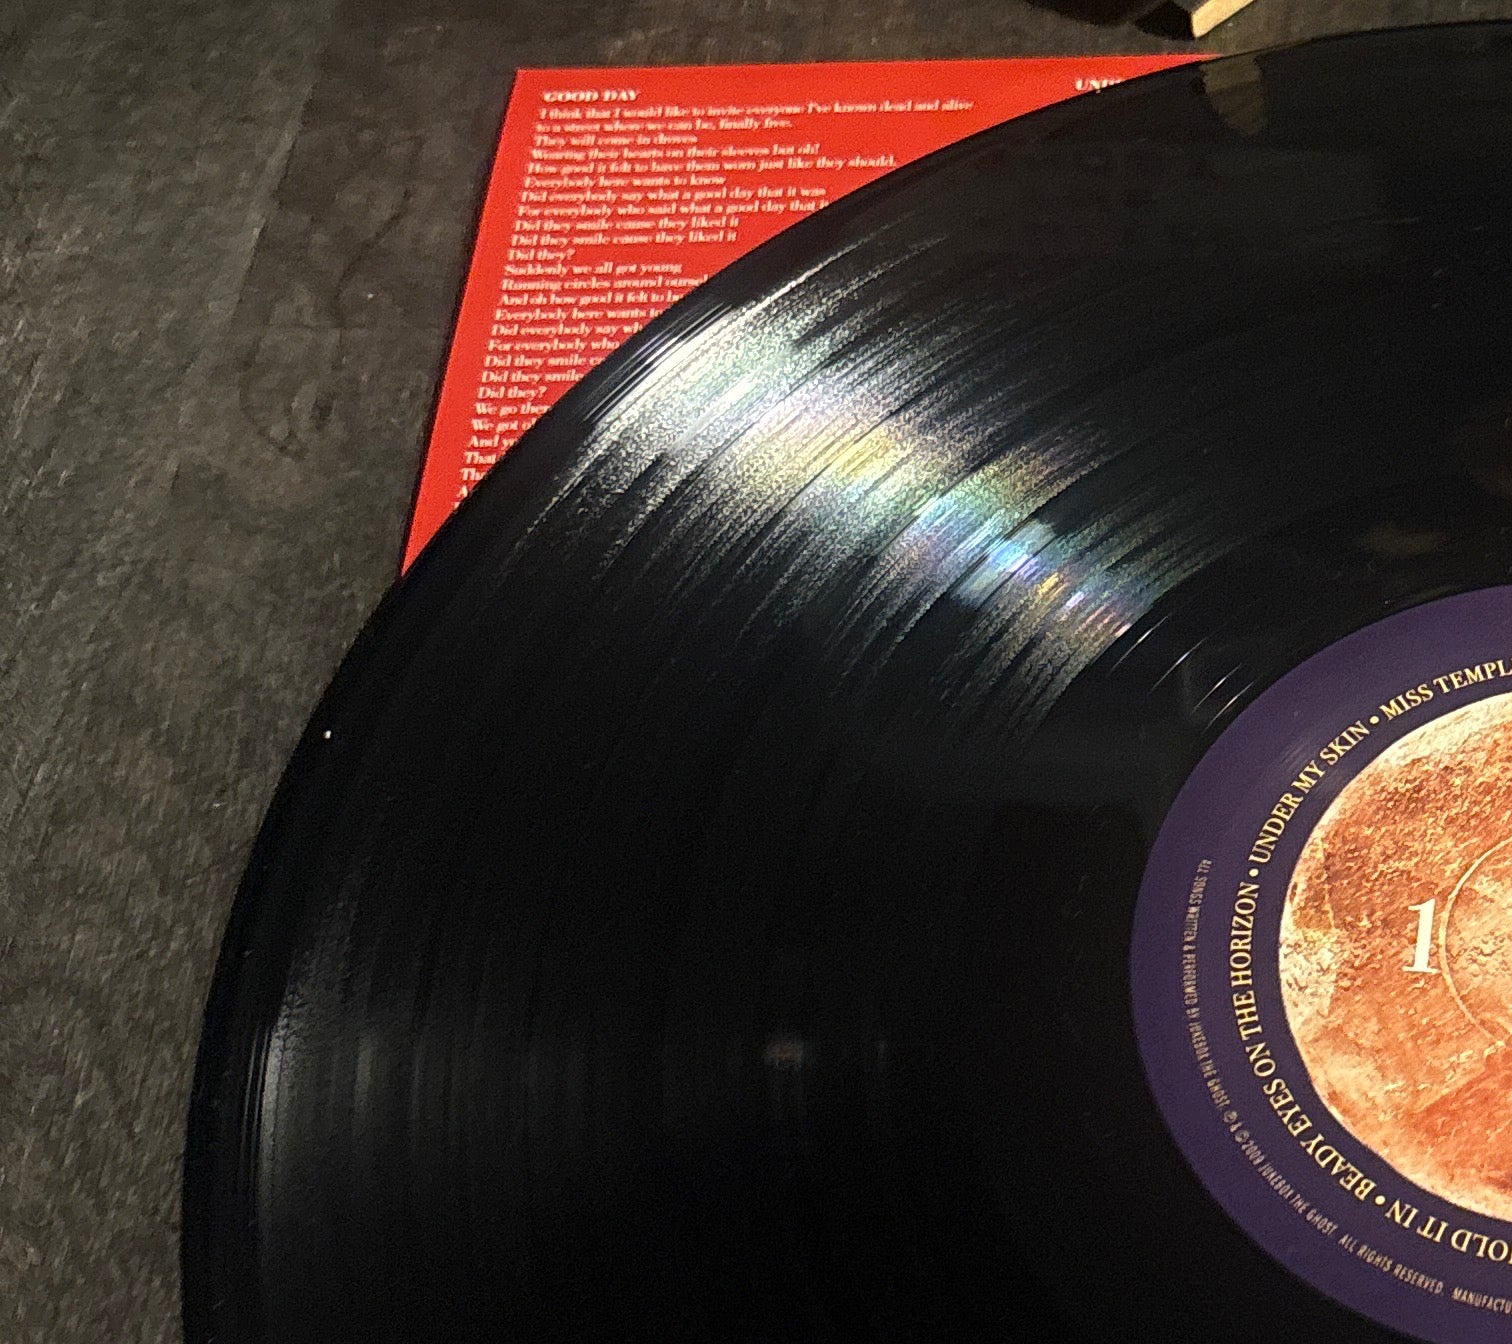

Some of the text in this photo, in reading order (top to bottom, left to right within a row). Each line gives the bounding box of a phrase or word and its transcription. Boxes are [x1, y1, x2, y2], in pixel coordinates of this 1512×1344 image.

[543, 89, 640, 102] GOOD DAY
[475, 402, 497, 414] We
[477, 386, 547, 400] Did they?
[1379, 683, 1434, 720] MISS
[1248, 720, 1370, 864] UNDER MY SKIN
[1402, 898, 1439, 974] 1
[1229, 881, 1377, 1201] BEADY EYES ON THE HORIZON
[1258, 1162, 1294, 1199] JUKEBOX
[1289, 1193, 1310, 1214] THE
[1338, 1234, 1358, 1253] ALL
[1356, 1244, 1393, 1273] RIGHTS
[1384, 1198, 1419, 1229] IN
[1416, 1216, 1449, 1243] IT
